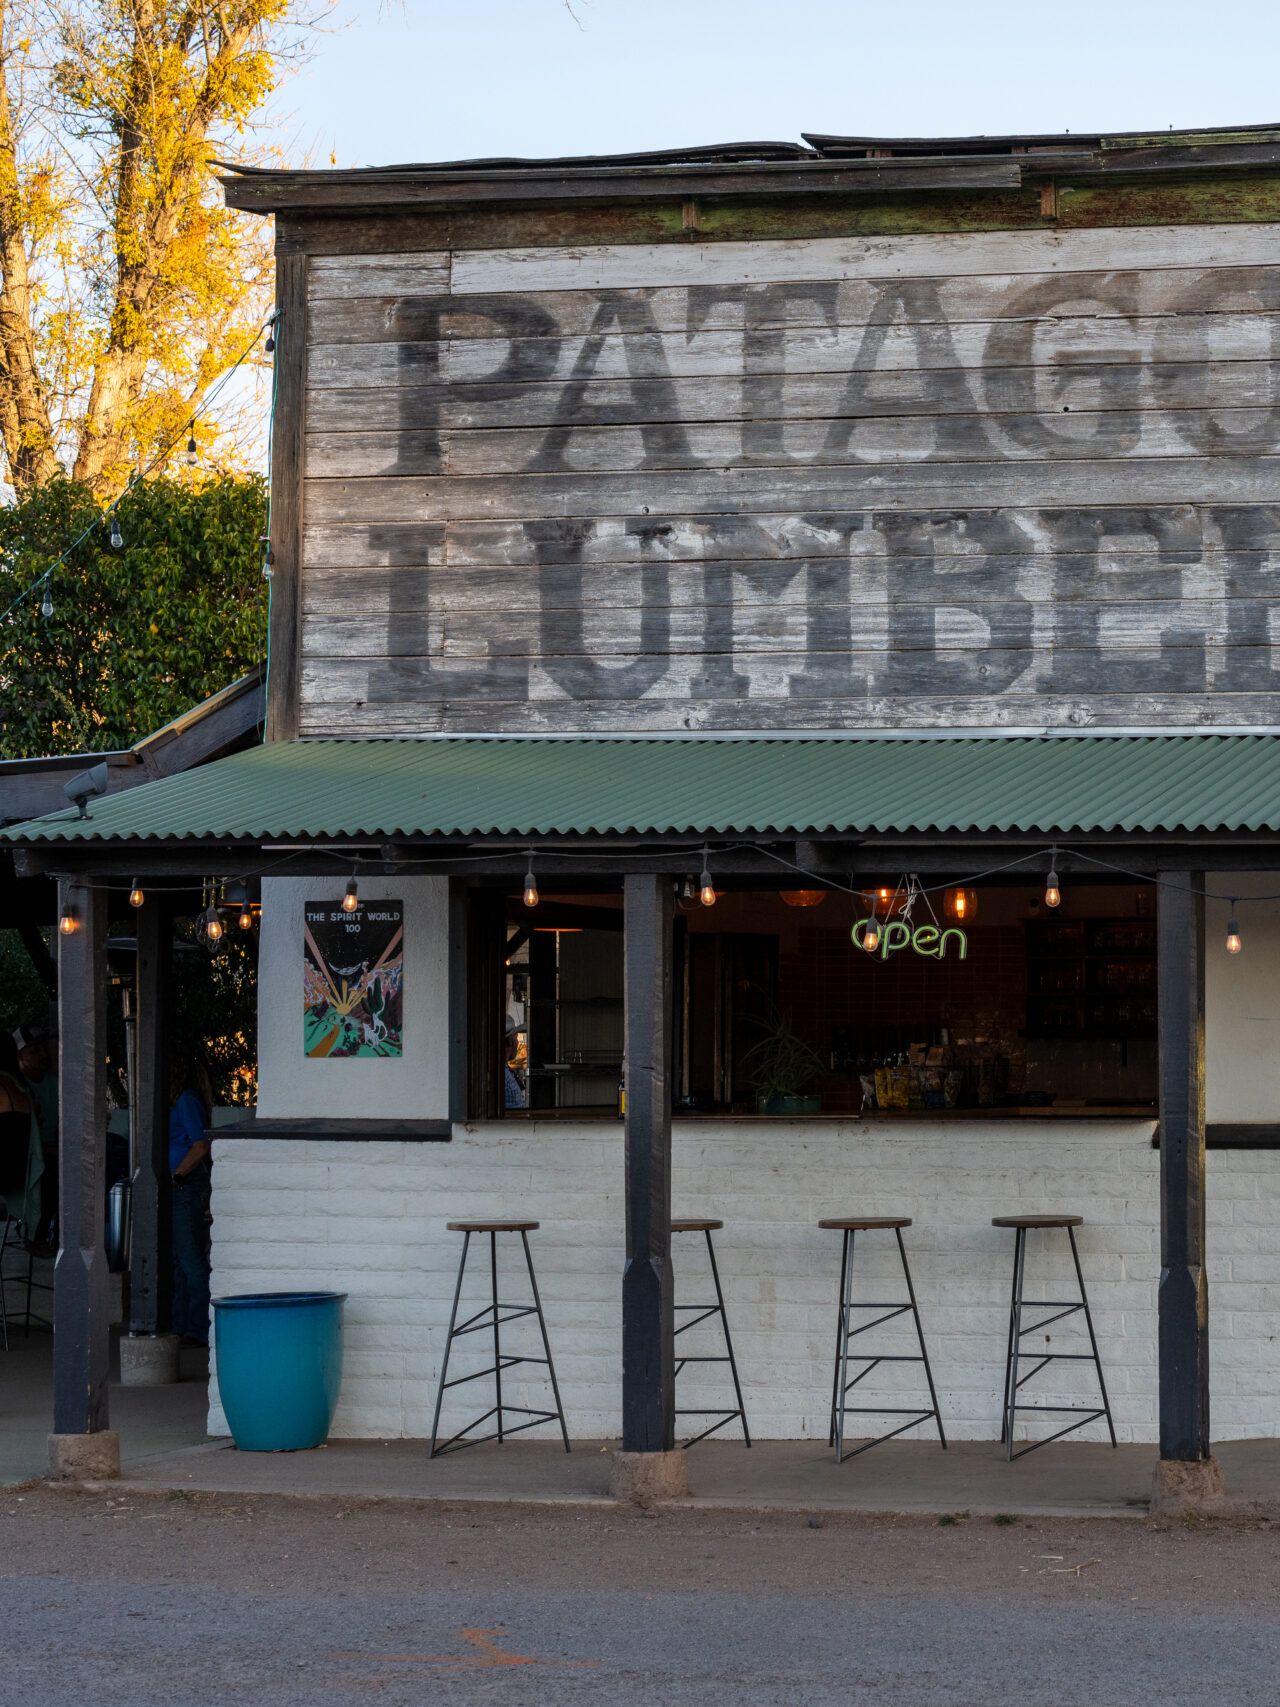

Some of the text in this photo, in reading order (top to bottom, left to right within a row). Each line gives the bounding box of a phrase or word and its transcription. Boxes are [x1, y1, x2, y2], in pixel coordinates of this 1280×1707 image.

[307, 912, 400, 921] THE SPIRIT WORLD
[345, 924, 361, 933] 100
